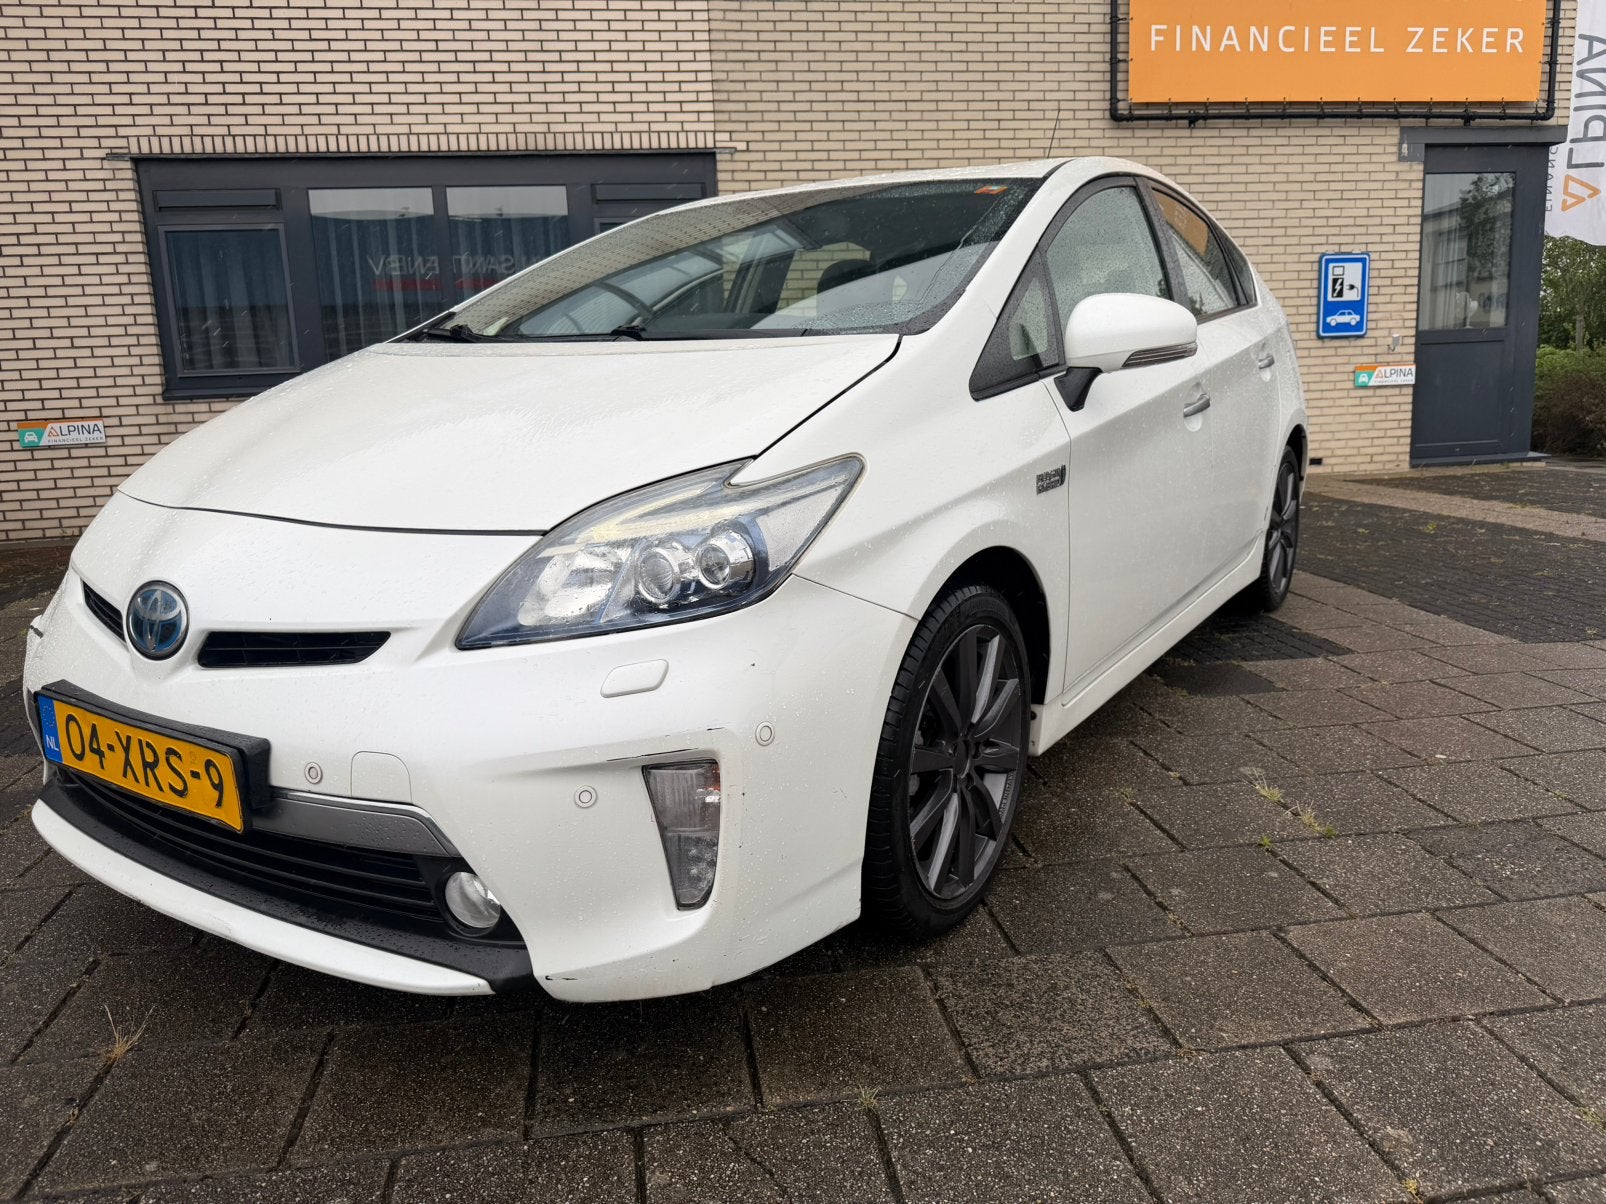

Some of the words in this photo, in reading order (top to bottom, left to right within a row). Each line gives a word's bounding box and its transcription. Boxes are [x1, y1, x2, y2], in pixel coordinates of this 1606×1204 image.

[1150, 25, 1384, 53] FINANCIEEL
[1406, 27, 1525, 54] ZEKER
[1375, 367, 1413, 379] ALPINA
[48, 423, 102, 437] ALPINA
[45, 733, 60, 752] NL
[65, 713, 224, 808] 04-XRS-9
